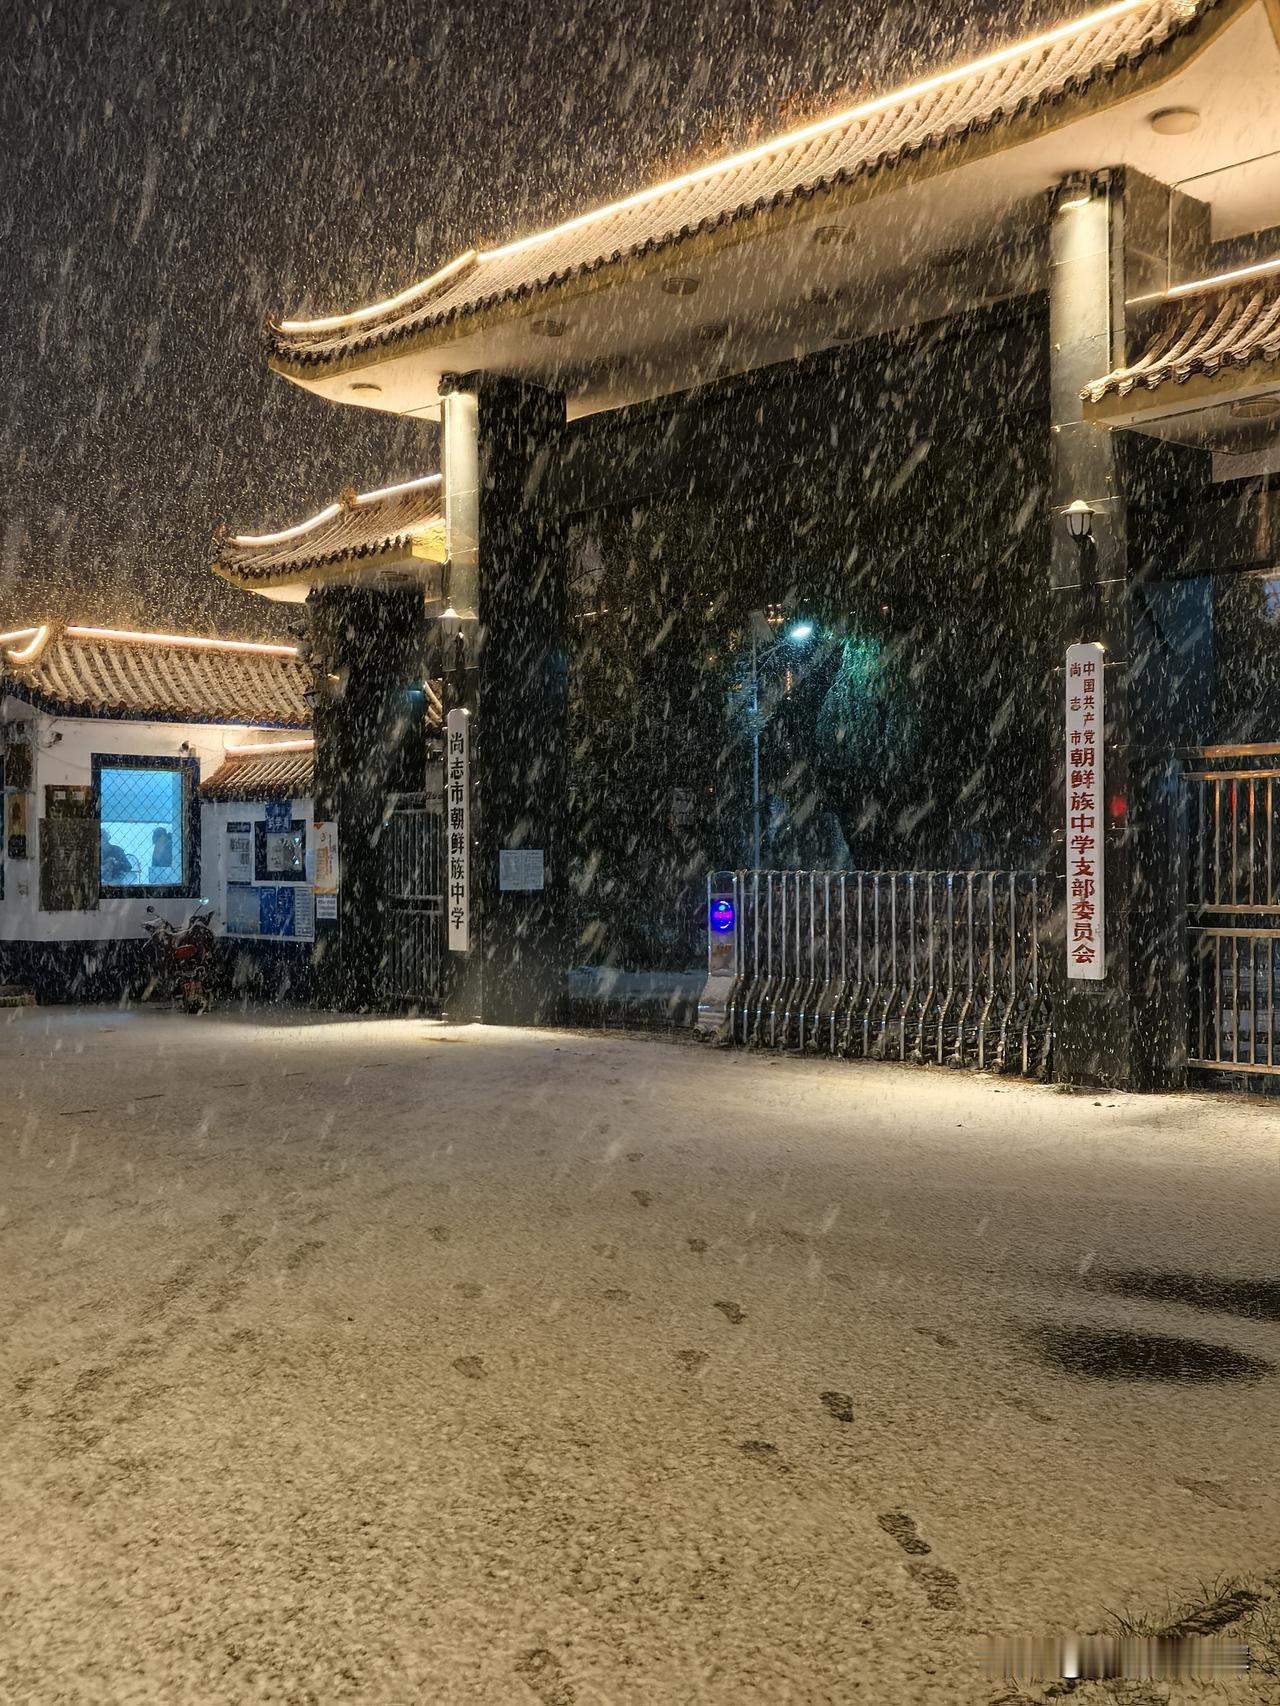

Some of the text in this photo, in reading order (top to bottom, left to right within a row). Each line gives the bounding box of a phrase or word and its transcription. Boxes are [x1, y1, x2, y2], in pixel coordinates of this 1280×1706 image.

[1070, 662, 1082, 746] 尚志市
[1083, 660, 1096, 745] 中国共产党
[450, 731, 465, 930] 尚志市朝鲜族中学
[1070, 747, 1096, 964] 朝鲜族中学支部委员会
